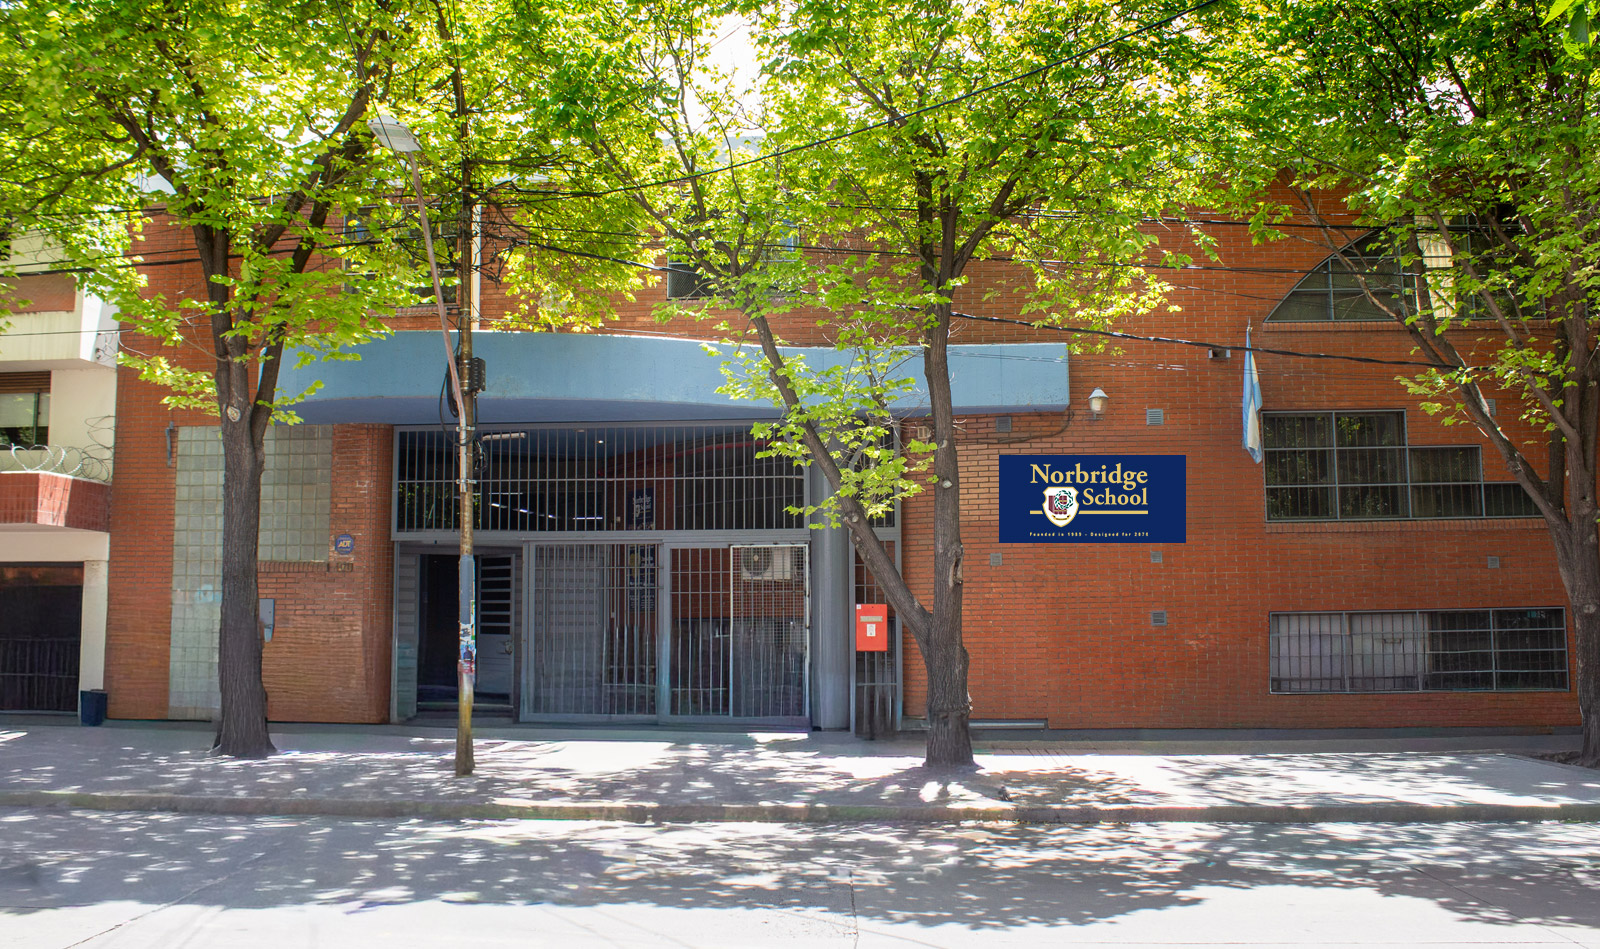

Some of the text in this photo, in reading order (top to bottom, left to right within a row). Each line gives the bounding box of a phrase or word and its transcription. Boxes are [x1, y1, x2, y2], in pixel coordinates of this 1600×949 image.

[1030, 463, 1148, 491] Norbridge
[1082, 488, 1148, 506] School
[338, 540, 351, 548] ADT
